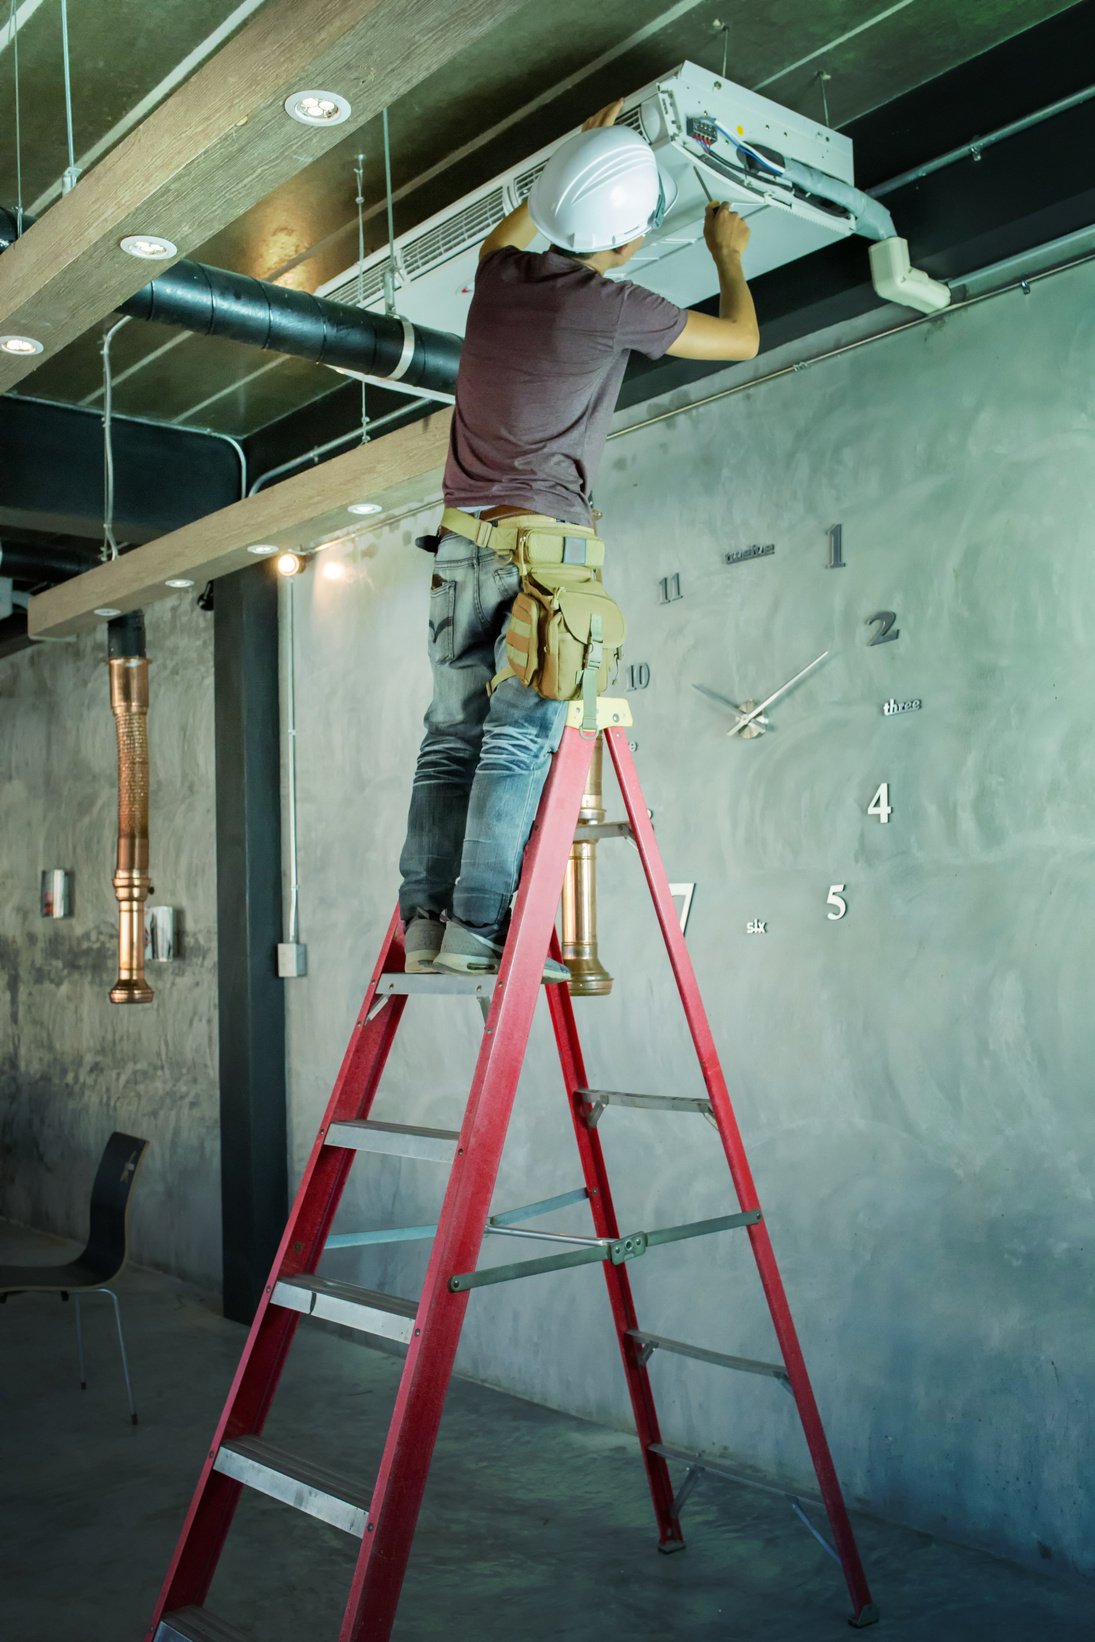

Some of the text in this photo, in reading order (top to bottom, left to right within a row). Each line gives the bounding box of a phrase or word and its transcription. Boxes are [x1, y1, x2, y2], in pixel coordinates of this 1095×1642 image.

[824, 523, 846, 569] 1
[658, 572, 683, 605] 11
[865, 611, 900, 646] 2
[626, 662, 651, 692] 10
[883, 698, 921, 716] three
[867, 782, 893, 824] 4
[826, 884, 847, 921] 5
[746, 919, 767, 934] six
